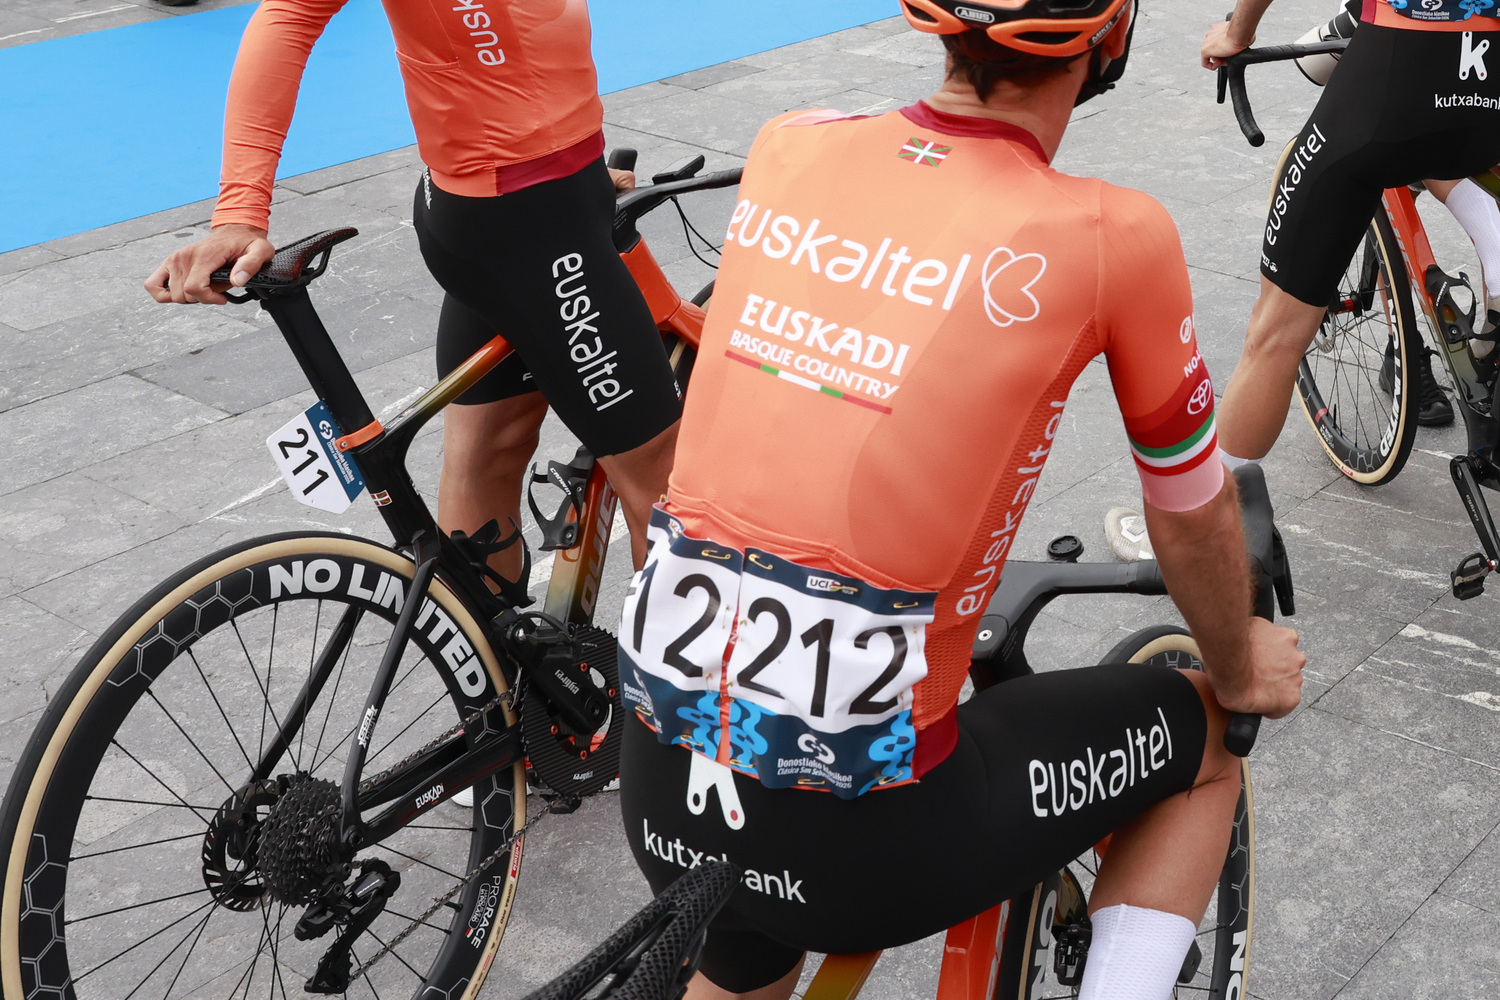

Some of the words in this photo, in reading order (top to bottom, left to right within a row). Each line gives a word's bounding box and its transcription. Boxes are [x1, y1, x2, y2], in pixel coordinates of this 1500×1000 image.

[959, 9, 991, 21] ABUS
[1091, 21, 1114, 43] MIKEL
[1265, 122, 1328, 246] euskaltel
[726, 198, 972, 311] euskaltel
[552, 252, 634, 412] euskaltel
[728, 329, 794, 368] BASQUE
[793, 352, 900, 400] COUNTRY
[738, 293, 912, 376] EUSKADI
[277, 427, 330, 497] 211
[956, 400, 1067, 617] euskaltel
[268, 558, 342, 600] NO
[809, 576, 830, 591] UCI
[628, 557, 721, 679] 12
[735, 596, 909, 719] 212
[777, 757, 823, 771] Donostiako
[822, 763, 853, 782] klasikoa
[777, 766, 800, 776] Clásica
[799, 766, 812, 774] San
[835, 779, 853, 789] 2026
[1028, 706, 1173, 818] euskaltel
[470, 875, 502, 949] PRORACE
